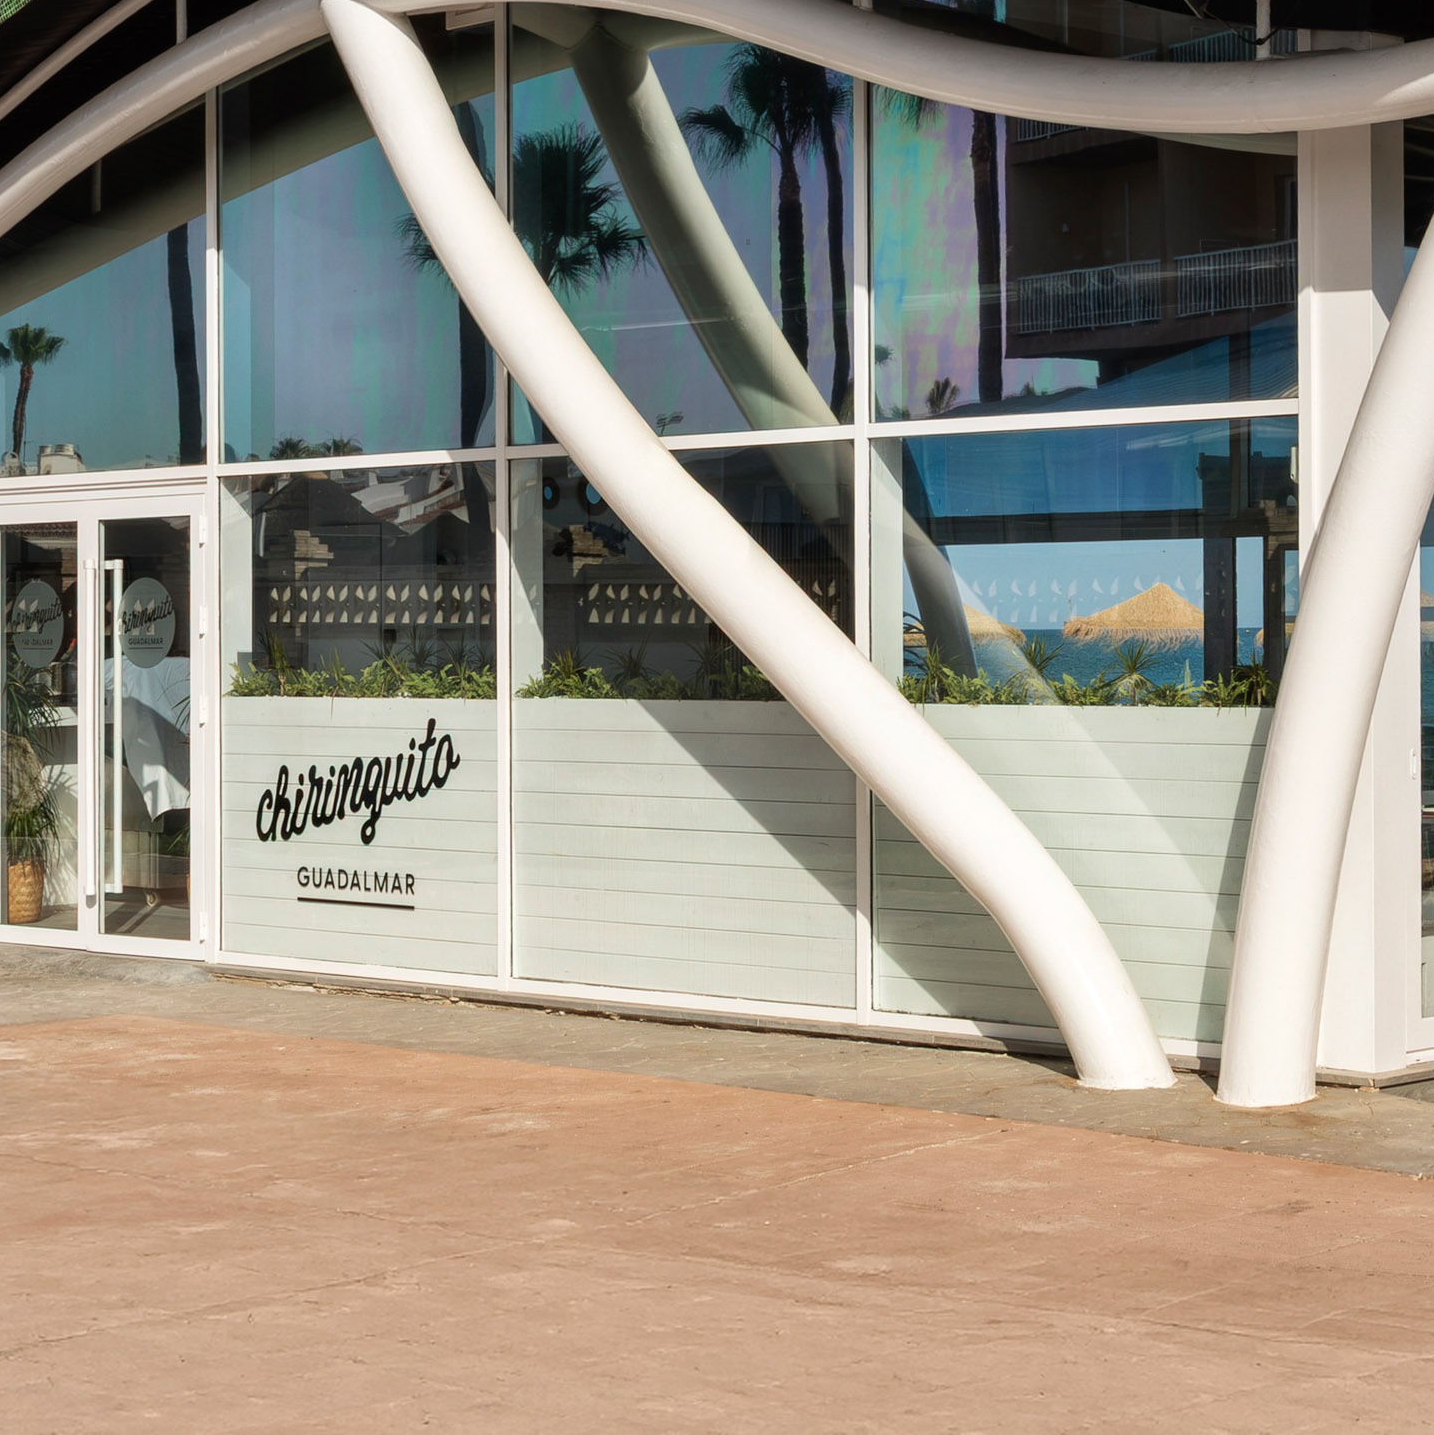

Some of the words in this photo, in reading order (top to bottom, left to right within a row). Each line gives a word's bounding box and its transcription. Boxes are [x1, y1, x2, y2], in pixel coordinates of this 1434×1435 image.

[128, 637, 164, 645] GUADALMAR
[256, 718, 460, 846] chiringuito
[297, 866, 415, 895] GUADALMAR
